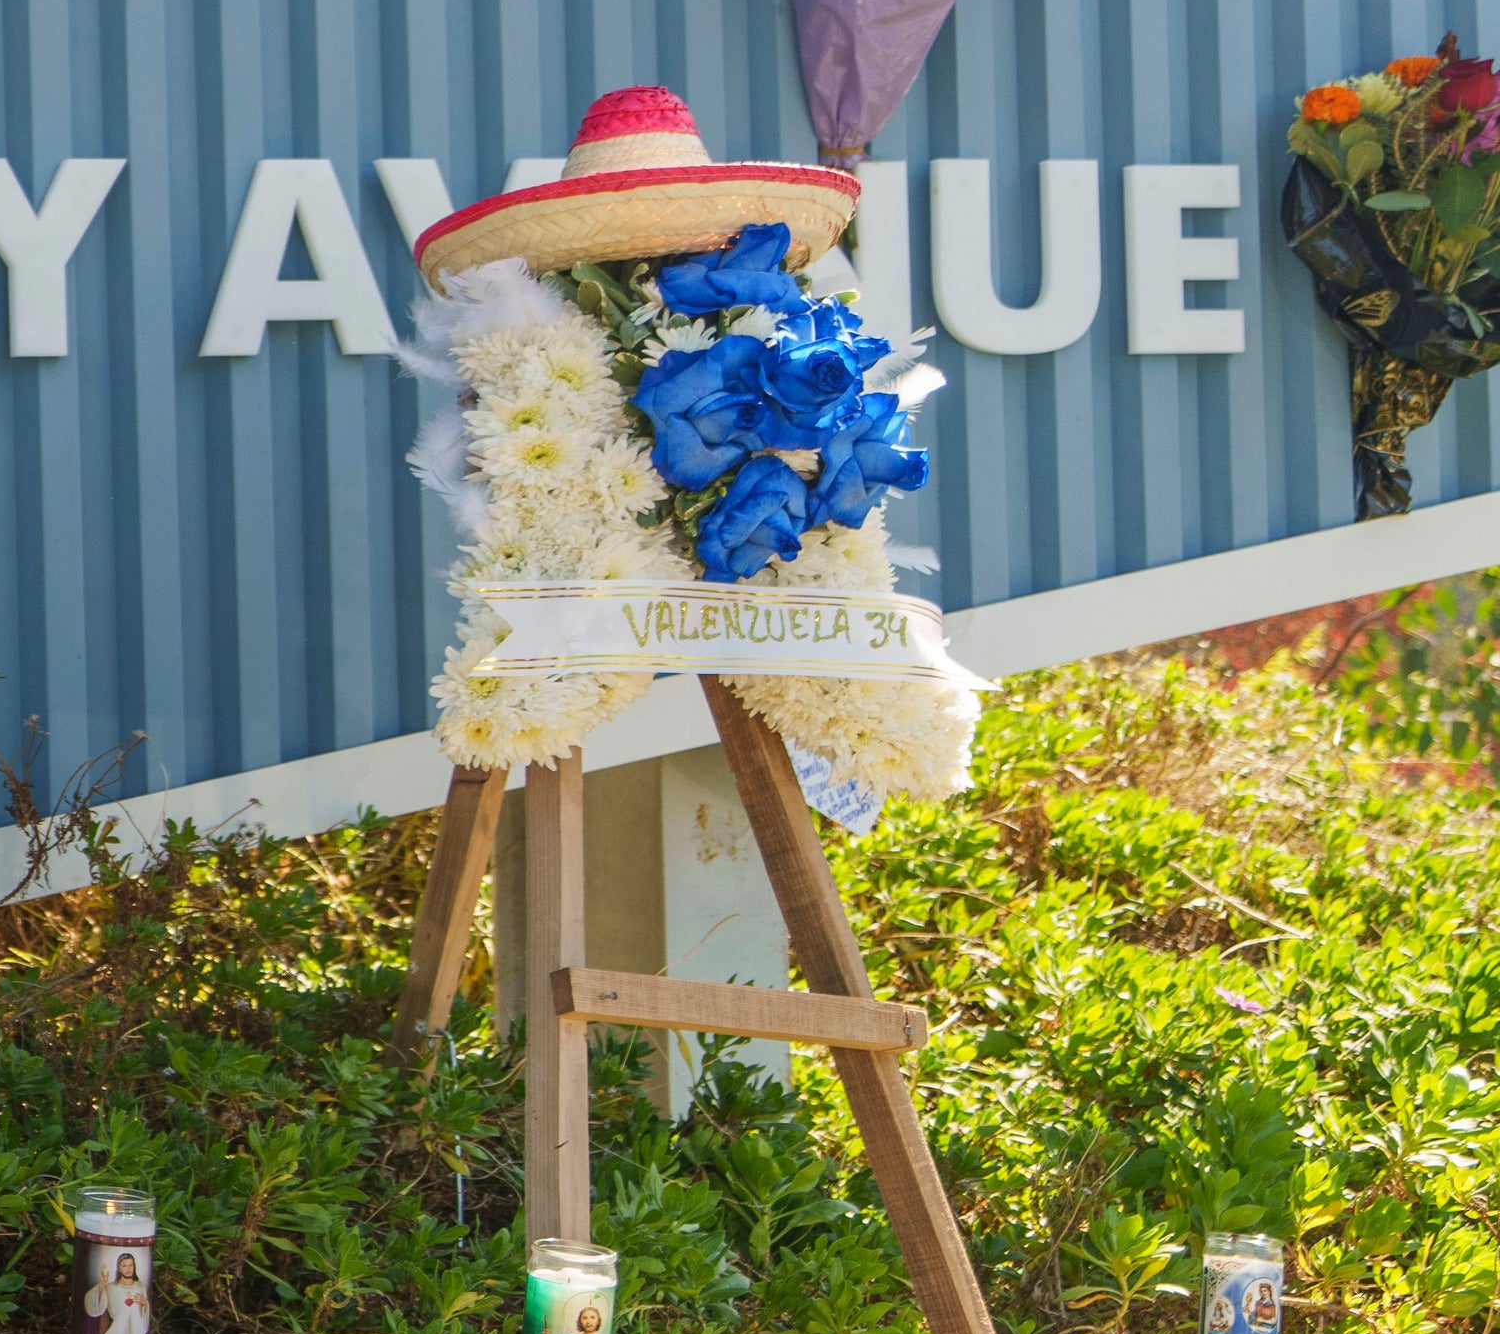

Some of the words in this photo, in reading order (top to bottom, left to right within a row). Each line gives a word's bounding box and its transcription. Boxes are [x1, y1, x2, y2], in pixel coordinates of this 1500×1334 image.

[198, 156, 1246, 359] ANUE
[621, 600, 852, 649] VALENZUELA
[864, 611, 909, 650] 34
